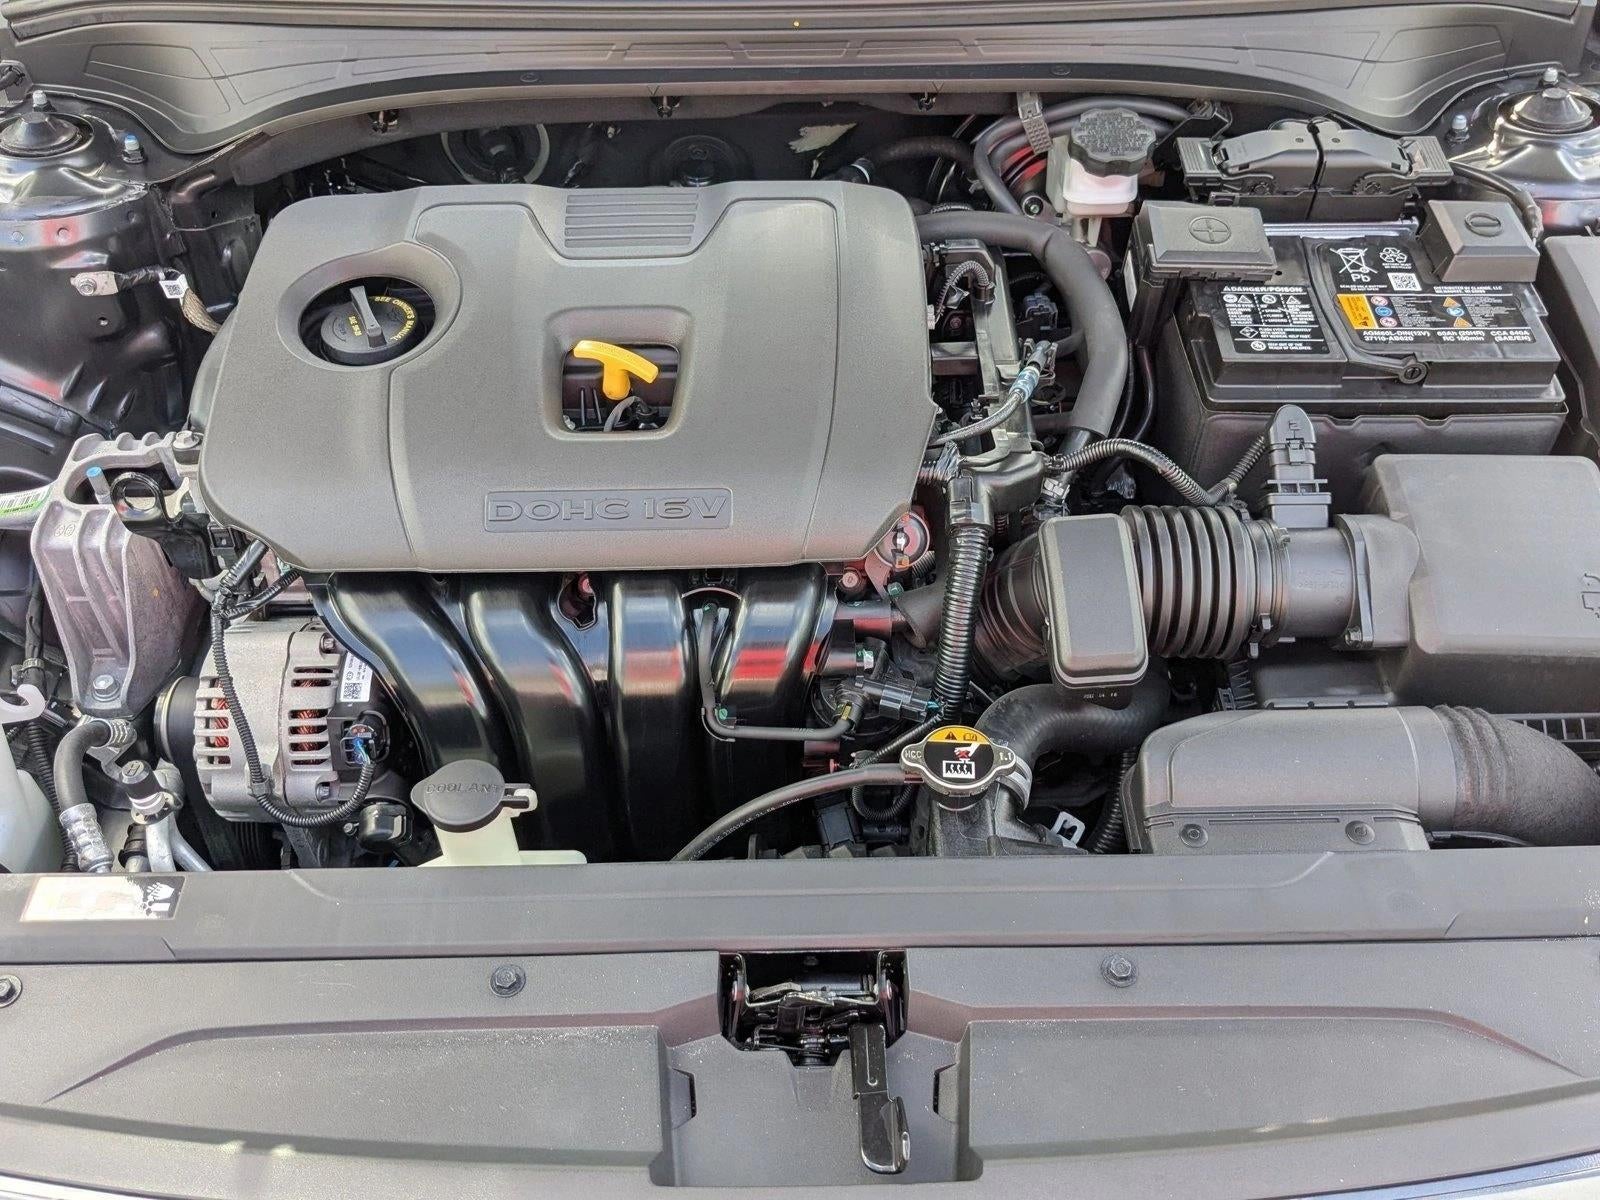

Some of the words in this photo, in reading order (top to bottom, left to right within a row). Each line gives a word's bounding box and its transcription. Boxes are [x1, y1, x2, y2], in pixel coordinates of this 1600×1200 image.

[1350, 273, 1371, 283] Pb
[392, 299, 415, 319] OWNER'S
[389, 320, 415, 341] MANUAL
[488, 498, 630, 521] DOHC
[644, 496, 727, 520] 16V
[905, 750, 922, 759] HCC
[999, 752, 1012, 761] 1.1
[426, 782, 501, 795] COOLANT
